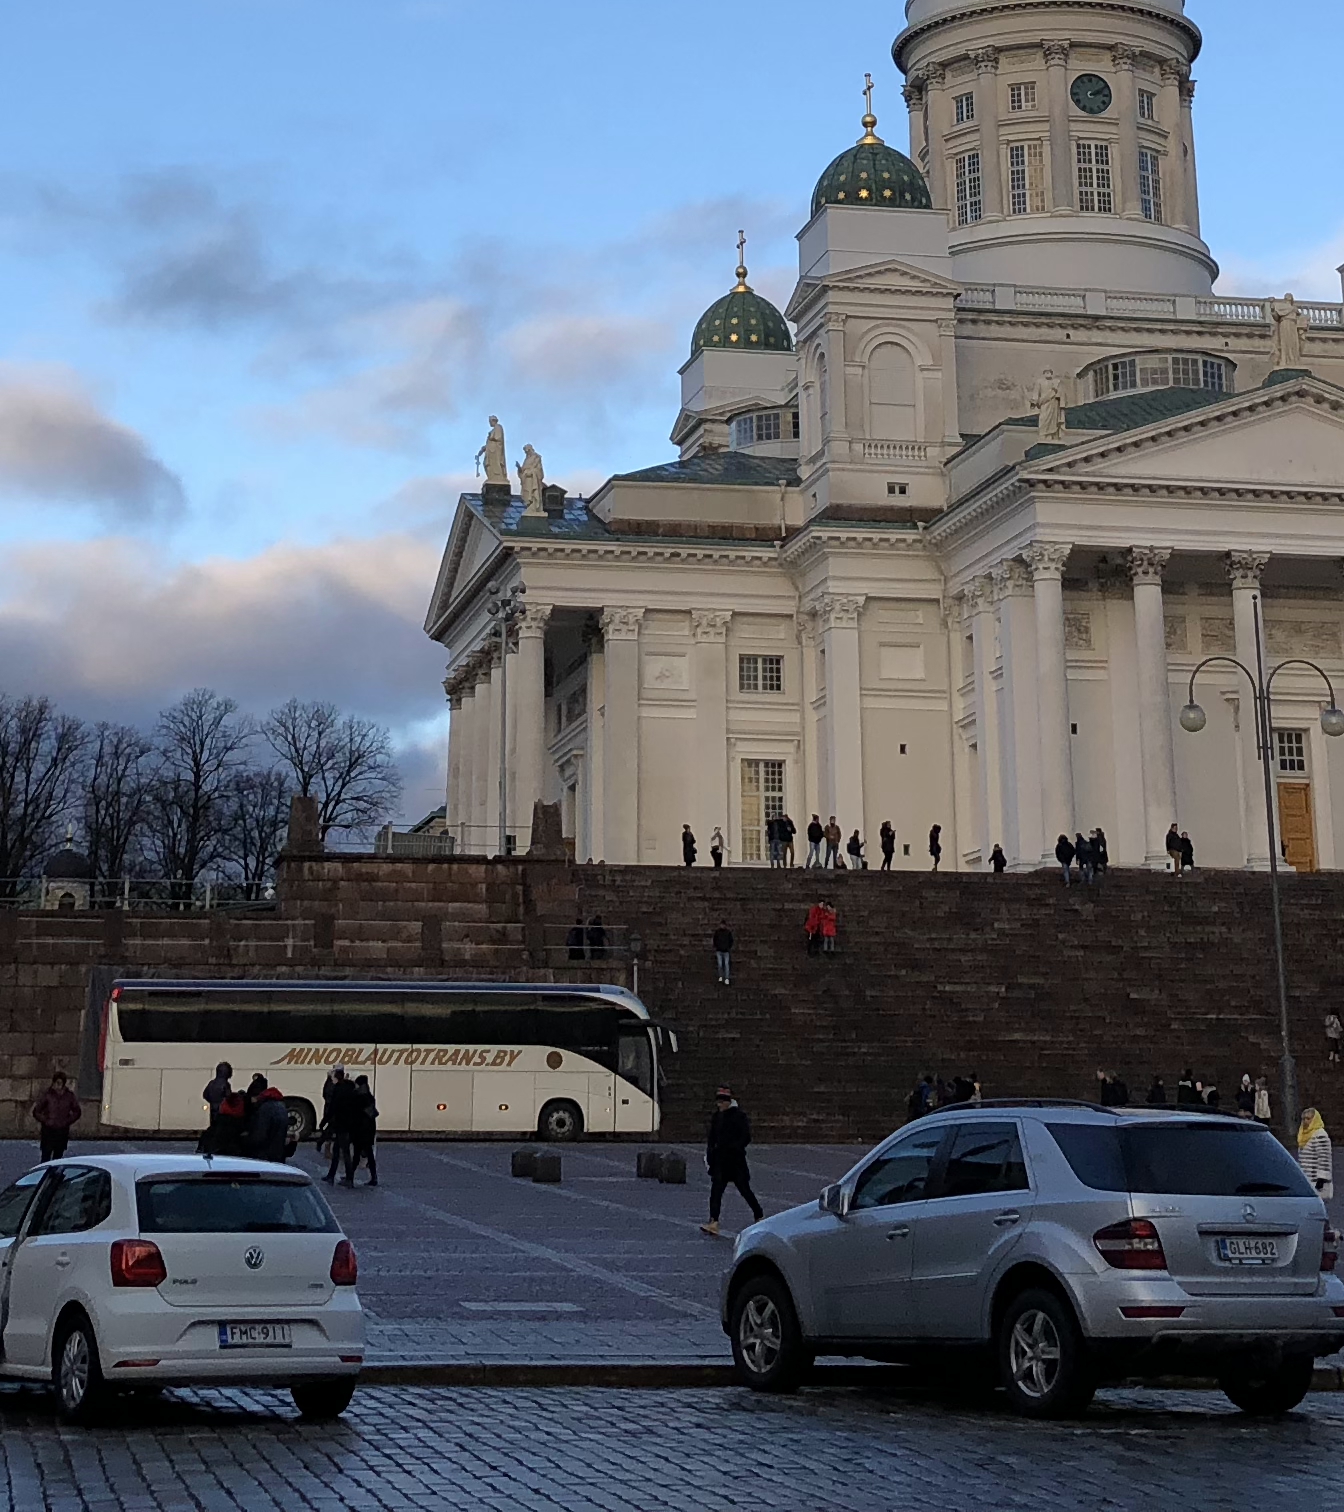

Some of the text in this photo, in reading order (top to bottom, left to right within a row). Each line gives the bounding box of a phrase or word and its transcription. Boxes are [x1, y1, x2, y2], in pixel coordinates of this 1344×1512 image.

[270, 1047, 523, 1067] MINOBLAUTOTRANS.BY
[1229, 1240, 1276, 1256] GLH-682
[230, 1325, 287, 1341] FMC-911
